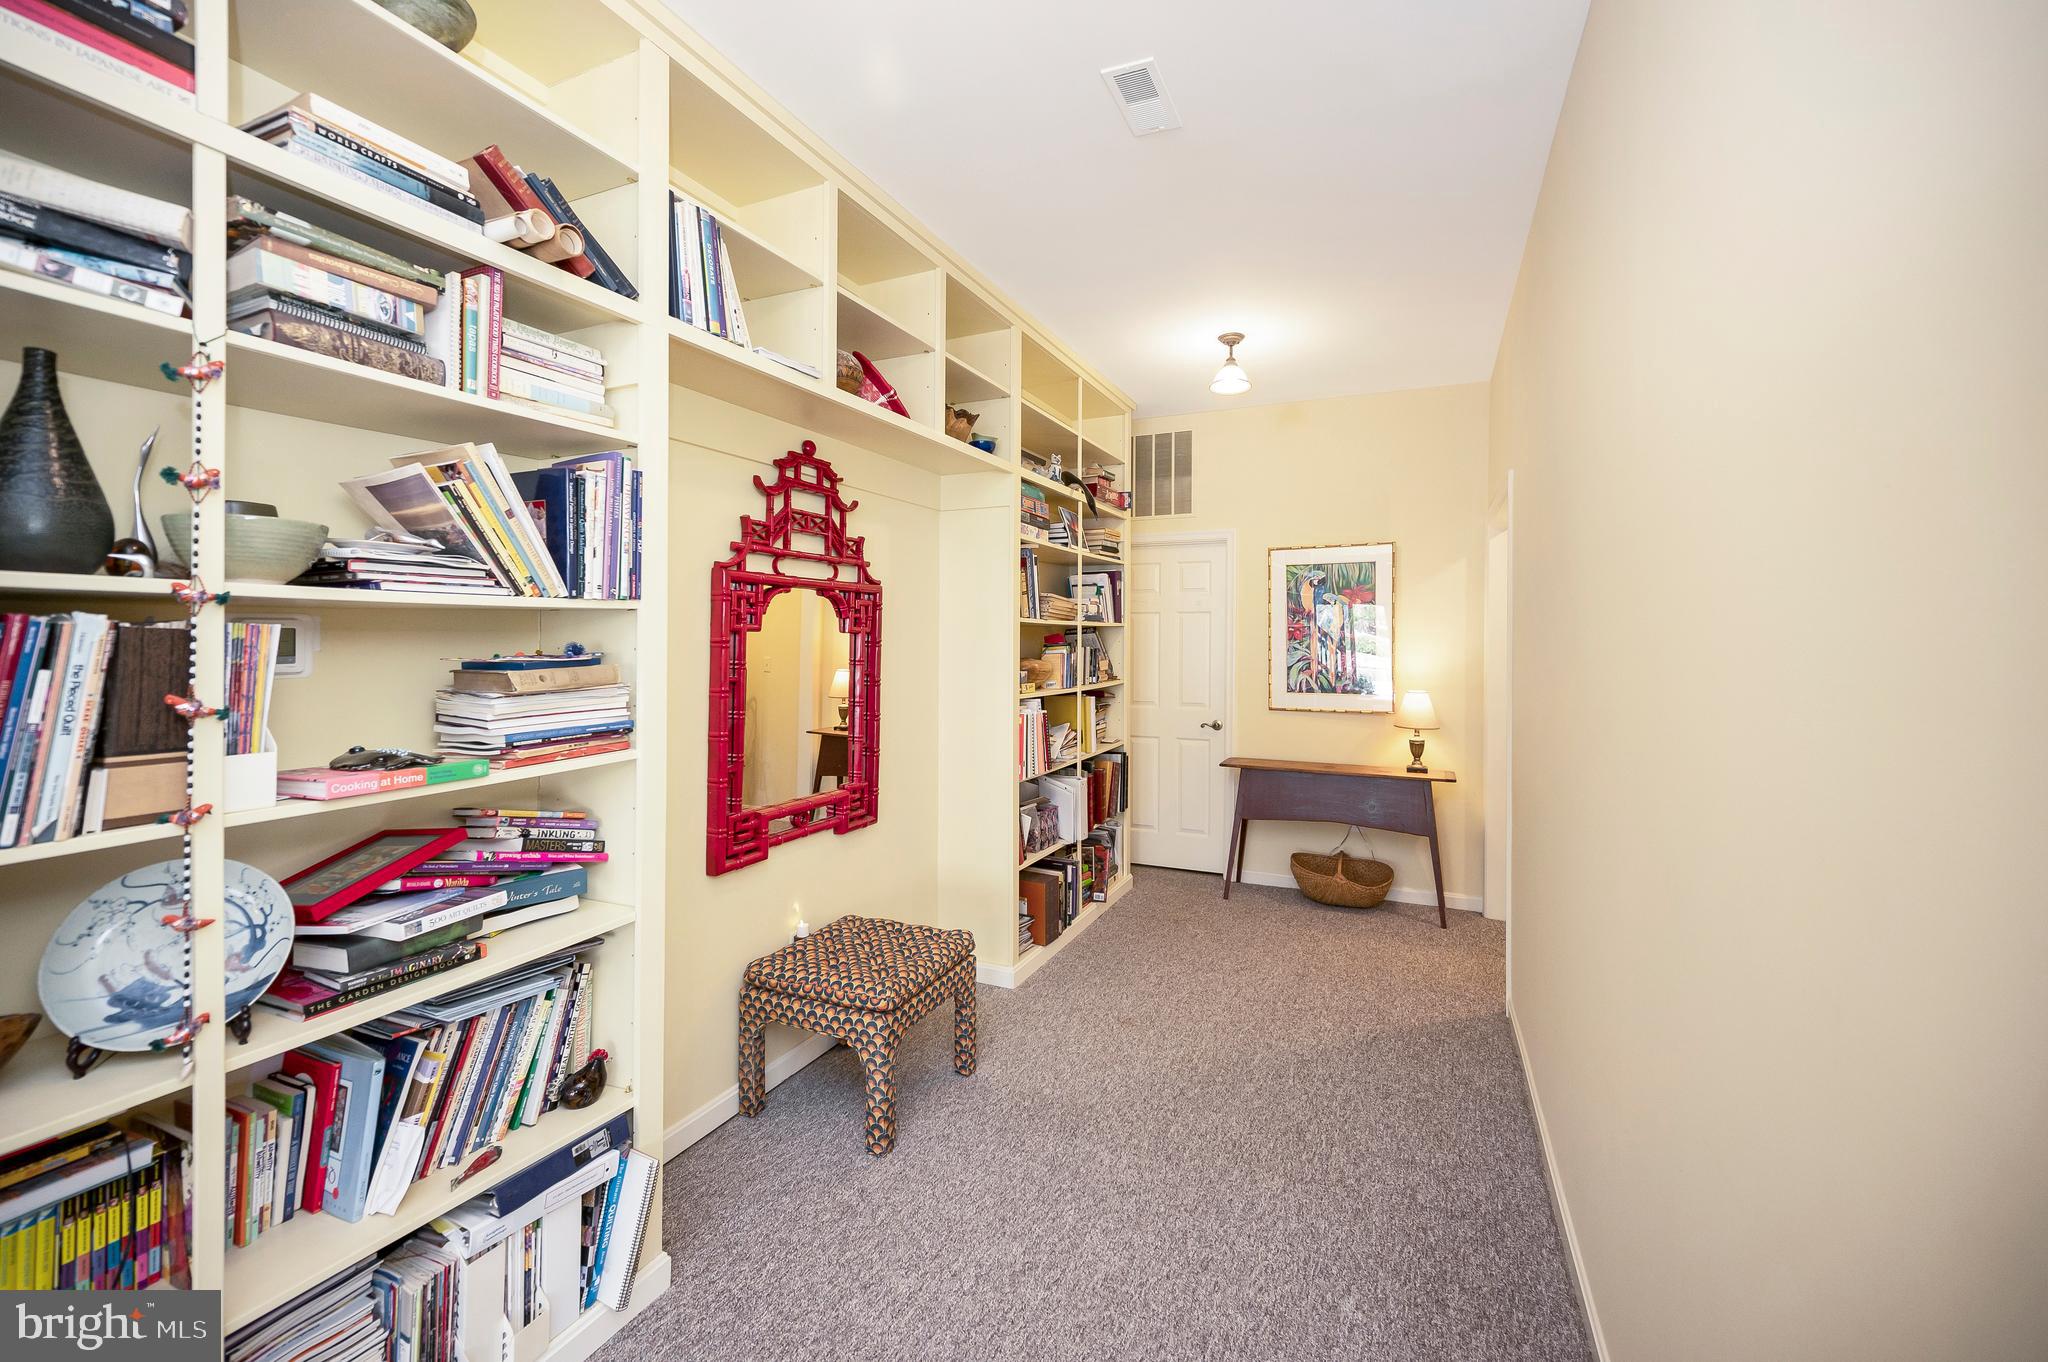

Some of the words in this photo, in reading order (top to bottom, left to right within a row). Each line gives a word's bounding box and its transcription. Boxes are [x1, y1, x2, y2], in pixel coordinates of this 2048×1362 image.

[316, 126, 358, 151] WORLD
[358, 146, 399, 170] CRAFTS
[706, 243, 714, 285] DECORATE
[467, 324, 477, 352] tapas
[72, 663, 83, 679] the
[64, 679, 80, 712] Pieced
[59, 713, 74, 737] Quilt
[330, 778, 378, 794] Cooking
[379, 776, 391, 786] at
[393, 772, 424, 784] Home
[525, 838, 567, 852] MASTERS
[444, 877, 470, 888] Matilda
[541, 883, 562, 895] Tale
[426, 914, 447, 928] 500
[446, 909, 463, 920] ART
[462, 901, 488, 915] QUILTS
[388, 951, 445, 978] IMAGINARY
[308, 999, 332, 1013] THE
[337, 982, 384, 1003] GARDEN
[388, 968, 426, 987] DESIGN
[431, 957, 459, 972] BOOK
[559, 1054, 568, 1075] REAL
[565, 1015, 577, 1049] MOTHER
[573, 986, 584, 1012] GOOSE
[612, 1176, 622, 1203] Ultimate
[600, 1203, 616, 1249] QUILTING
